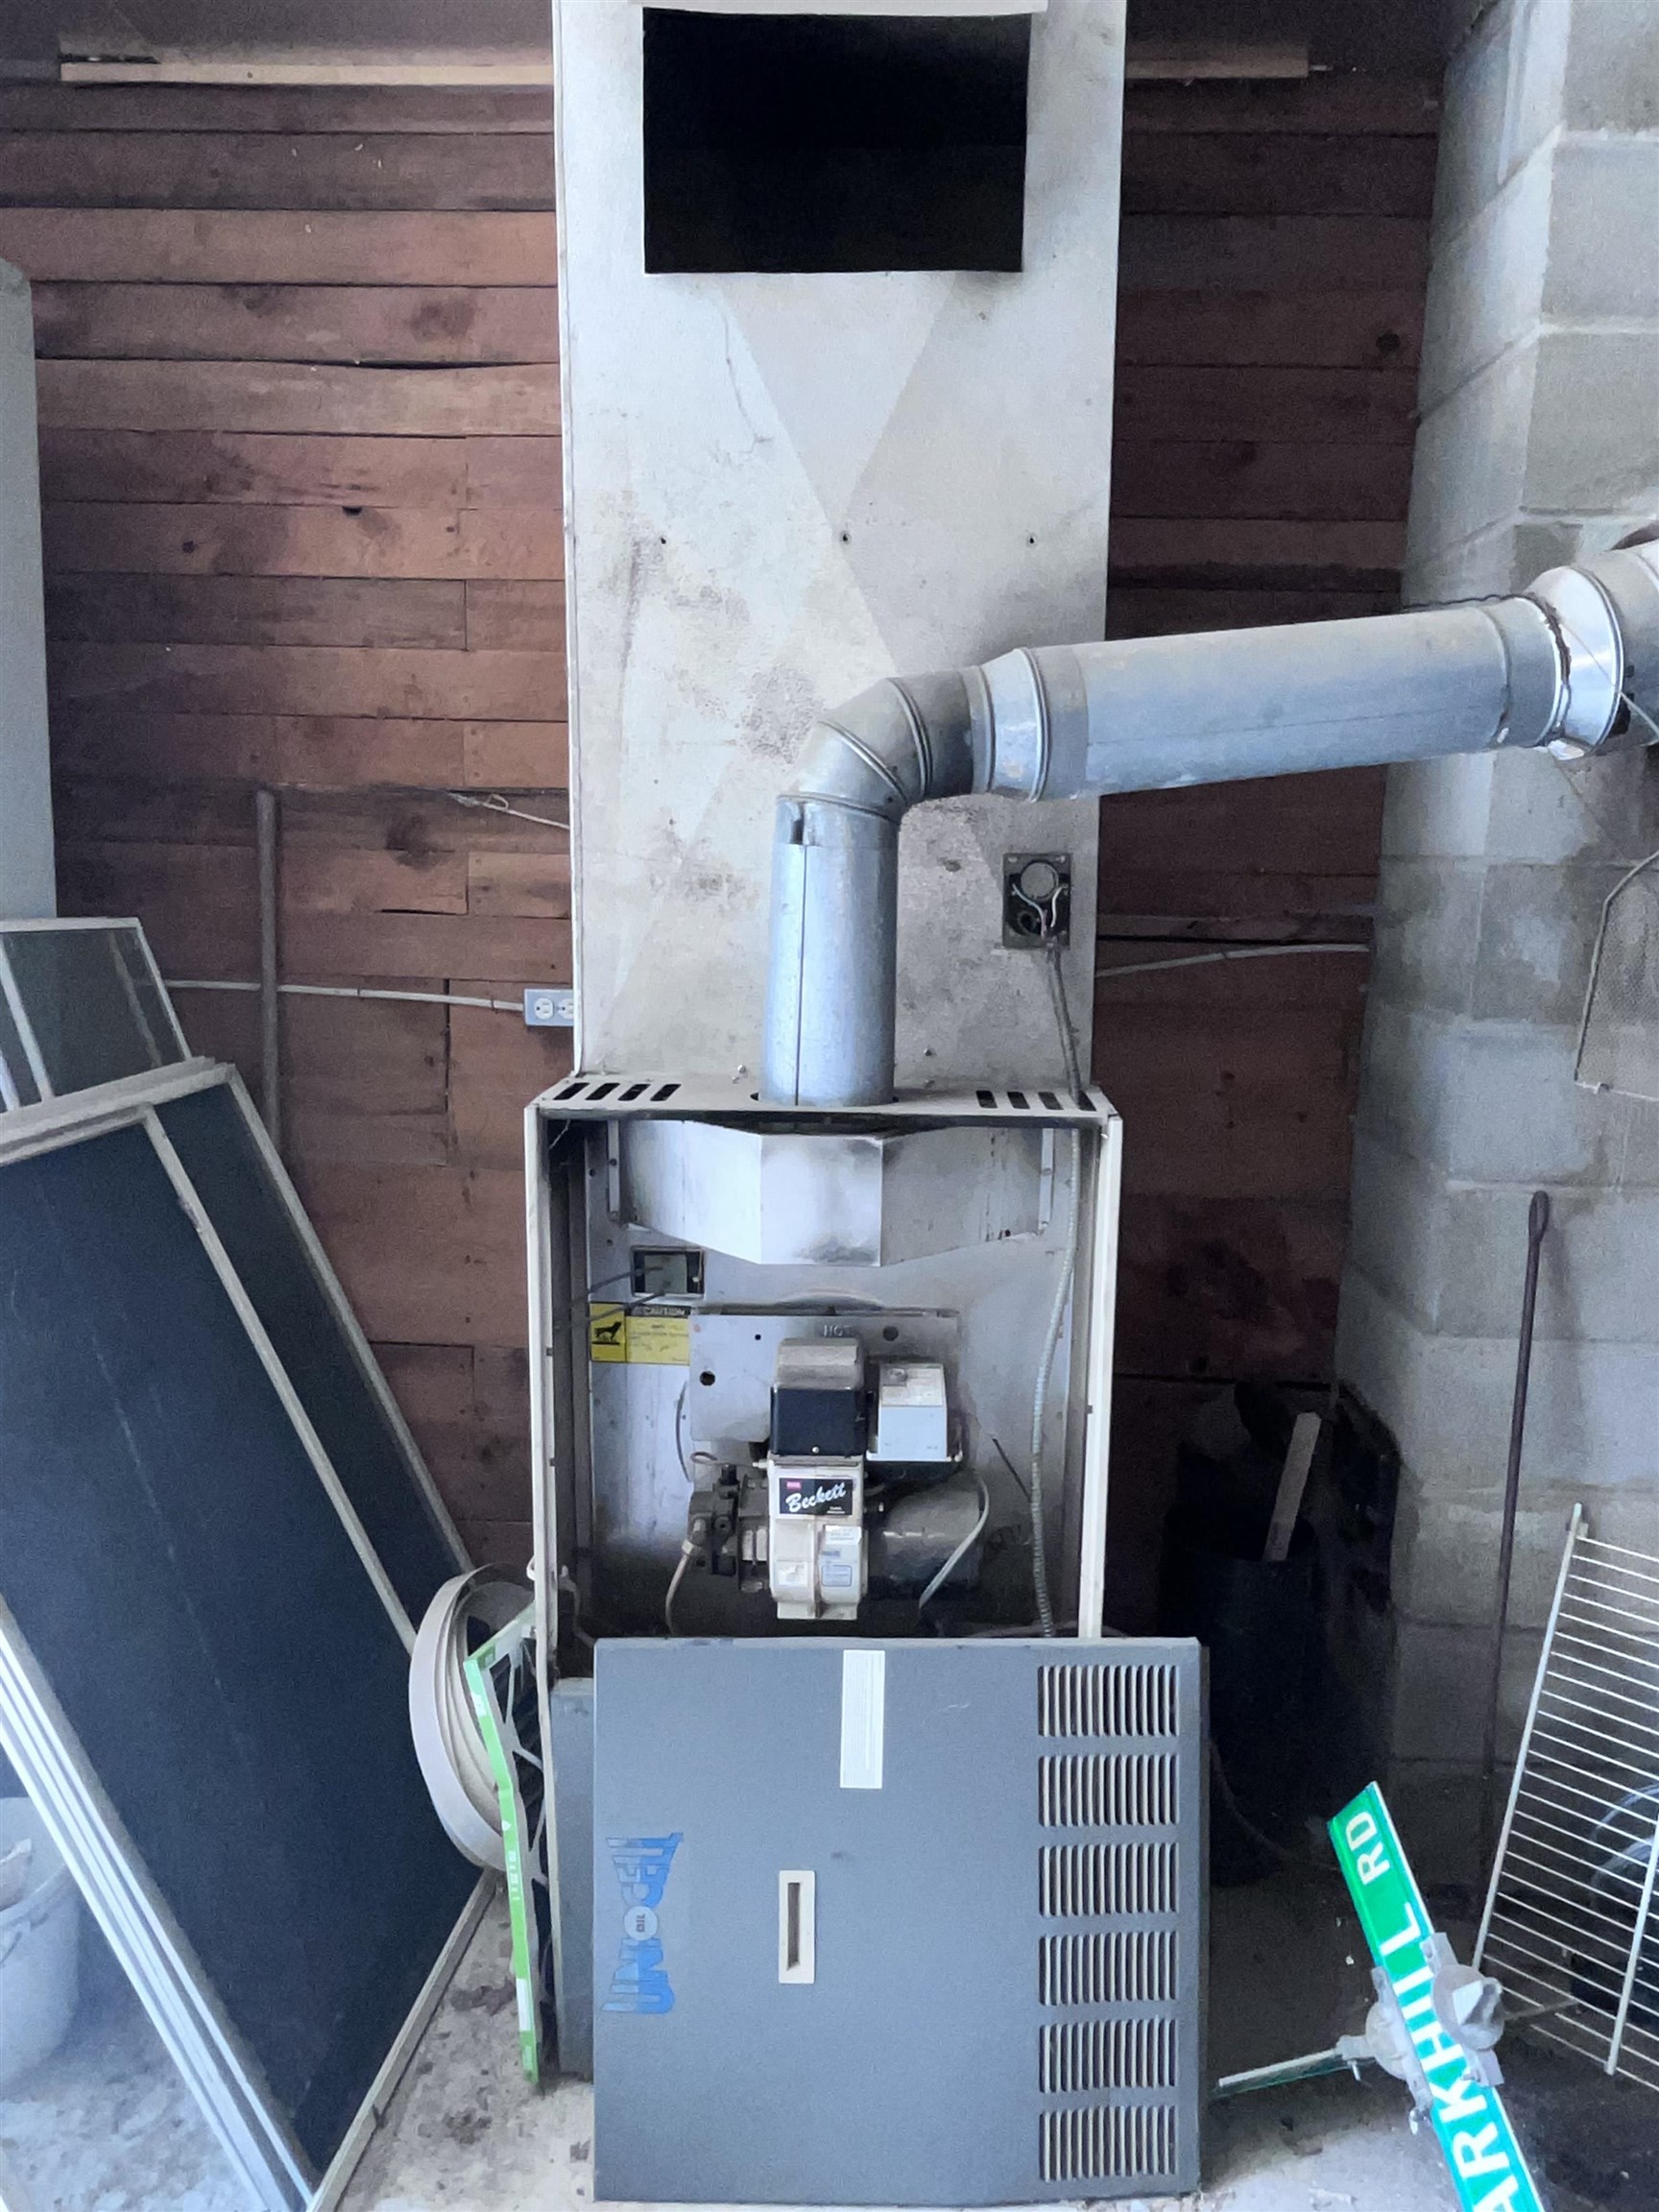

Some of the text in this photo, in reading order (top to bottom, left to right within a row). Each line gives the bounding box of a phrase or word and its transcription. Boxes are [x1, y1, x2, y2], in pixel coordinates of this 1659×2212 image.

[643, 1307, 685, 1316] CAUTION
[785, 1481, 847, 1513] Beckett
[1346, 1812, 1390, 1885] RD
